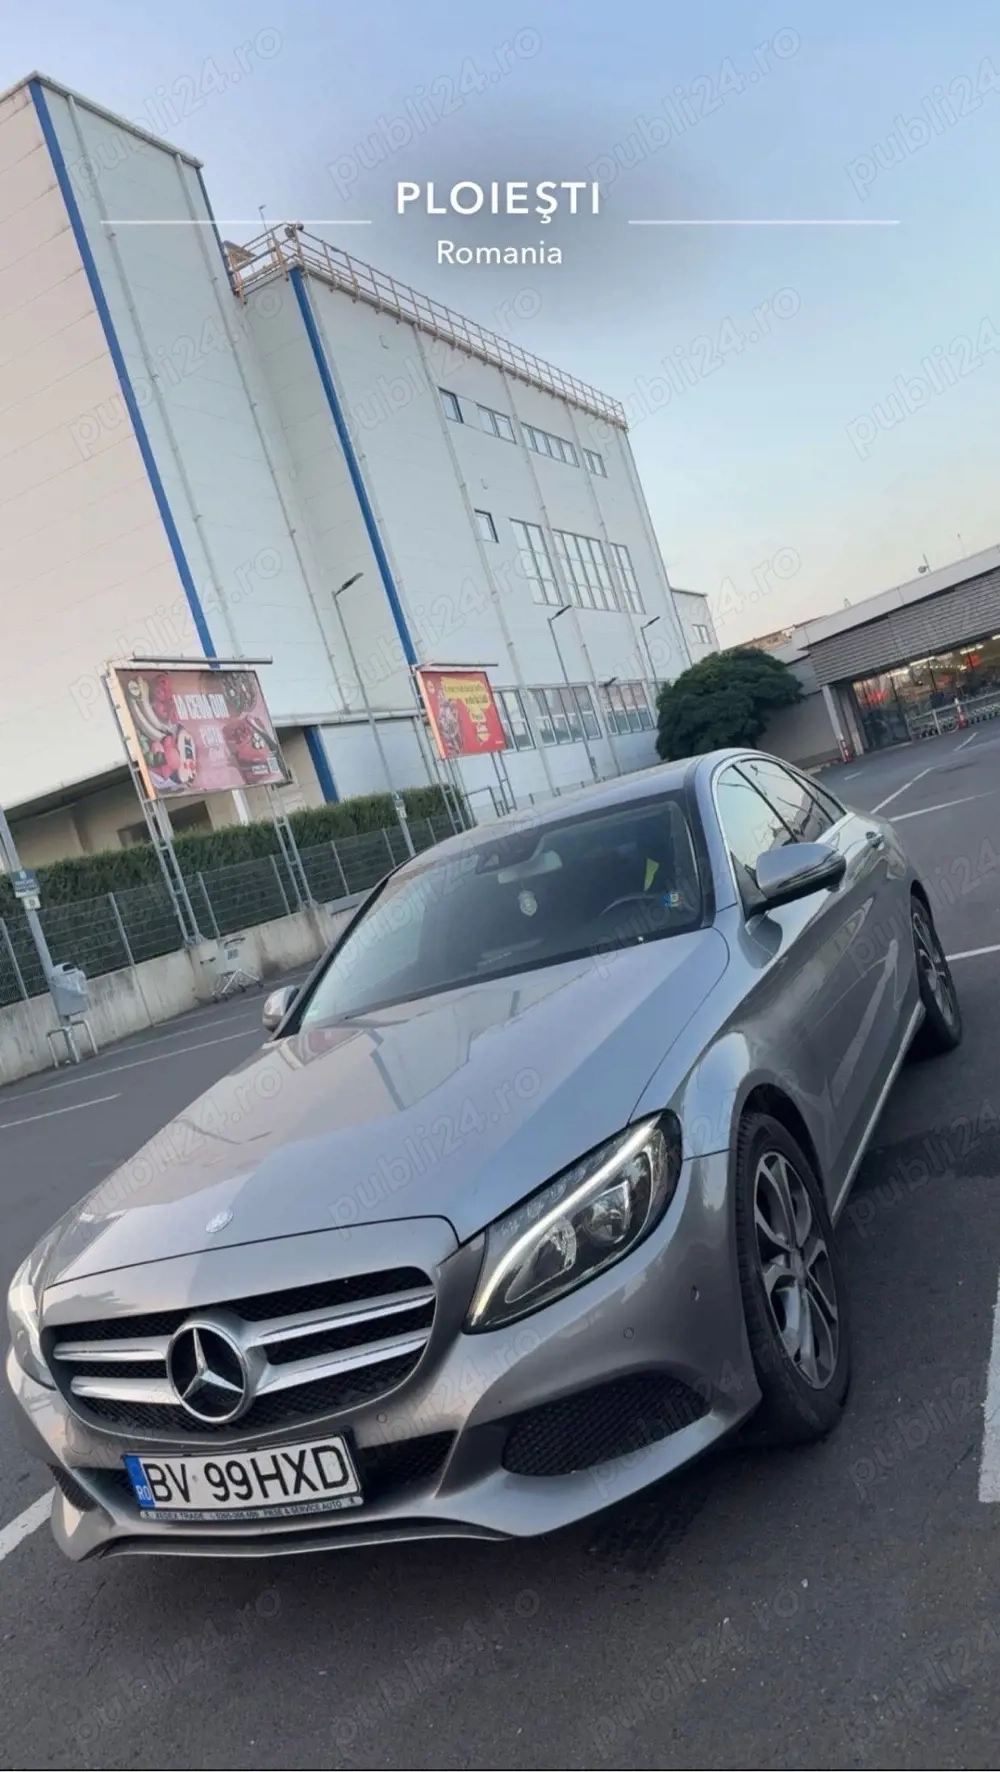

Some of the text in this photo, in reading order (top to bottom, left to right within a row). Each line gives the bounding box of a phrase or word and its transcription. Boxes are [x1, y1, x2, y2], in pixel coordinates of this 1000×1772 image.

[143, 1463, 191, 1503] BV
[137, 1485, 153, 1502] RO
[322, 1500, 342, 1511] AUTO
